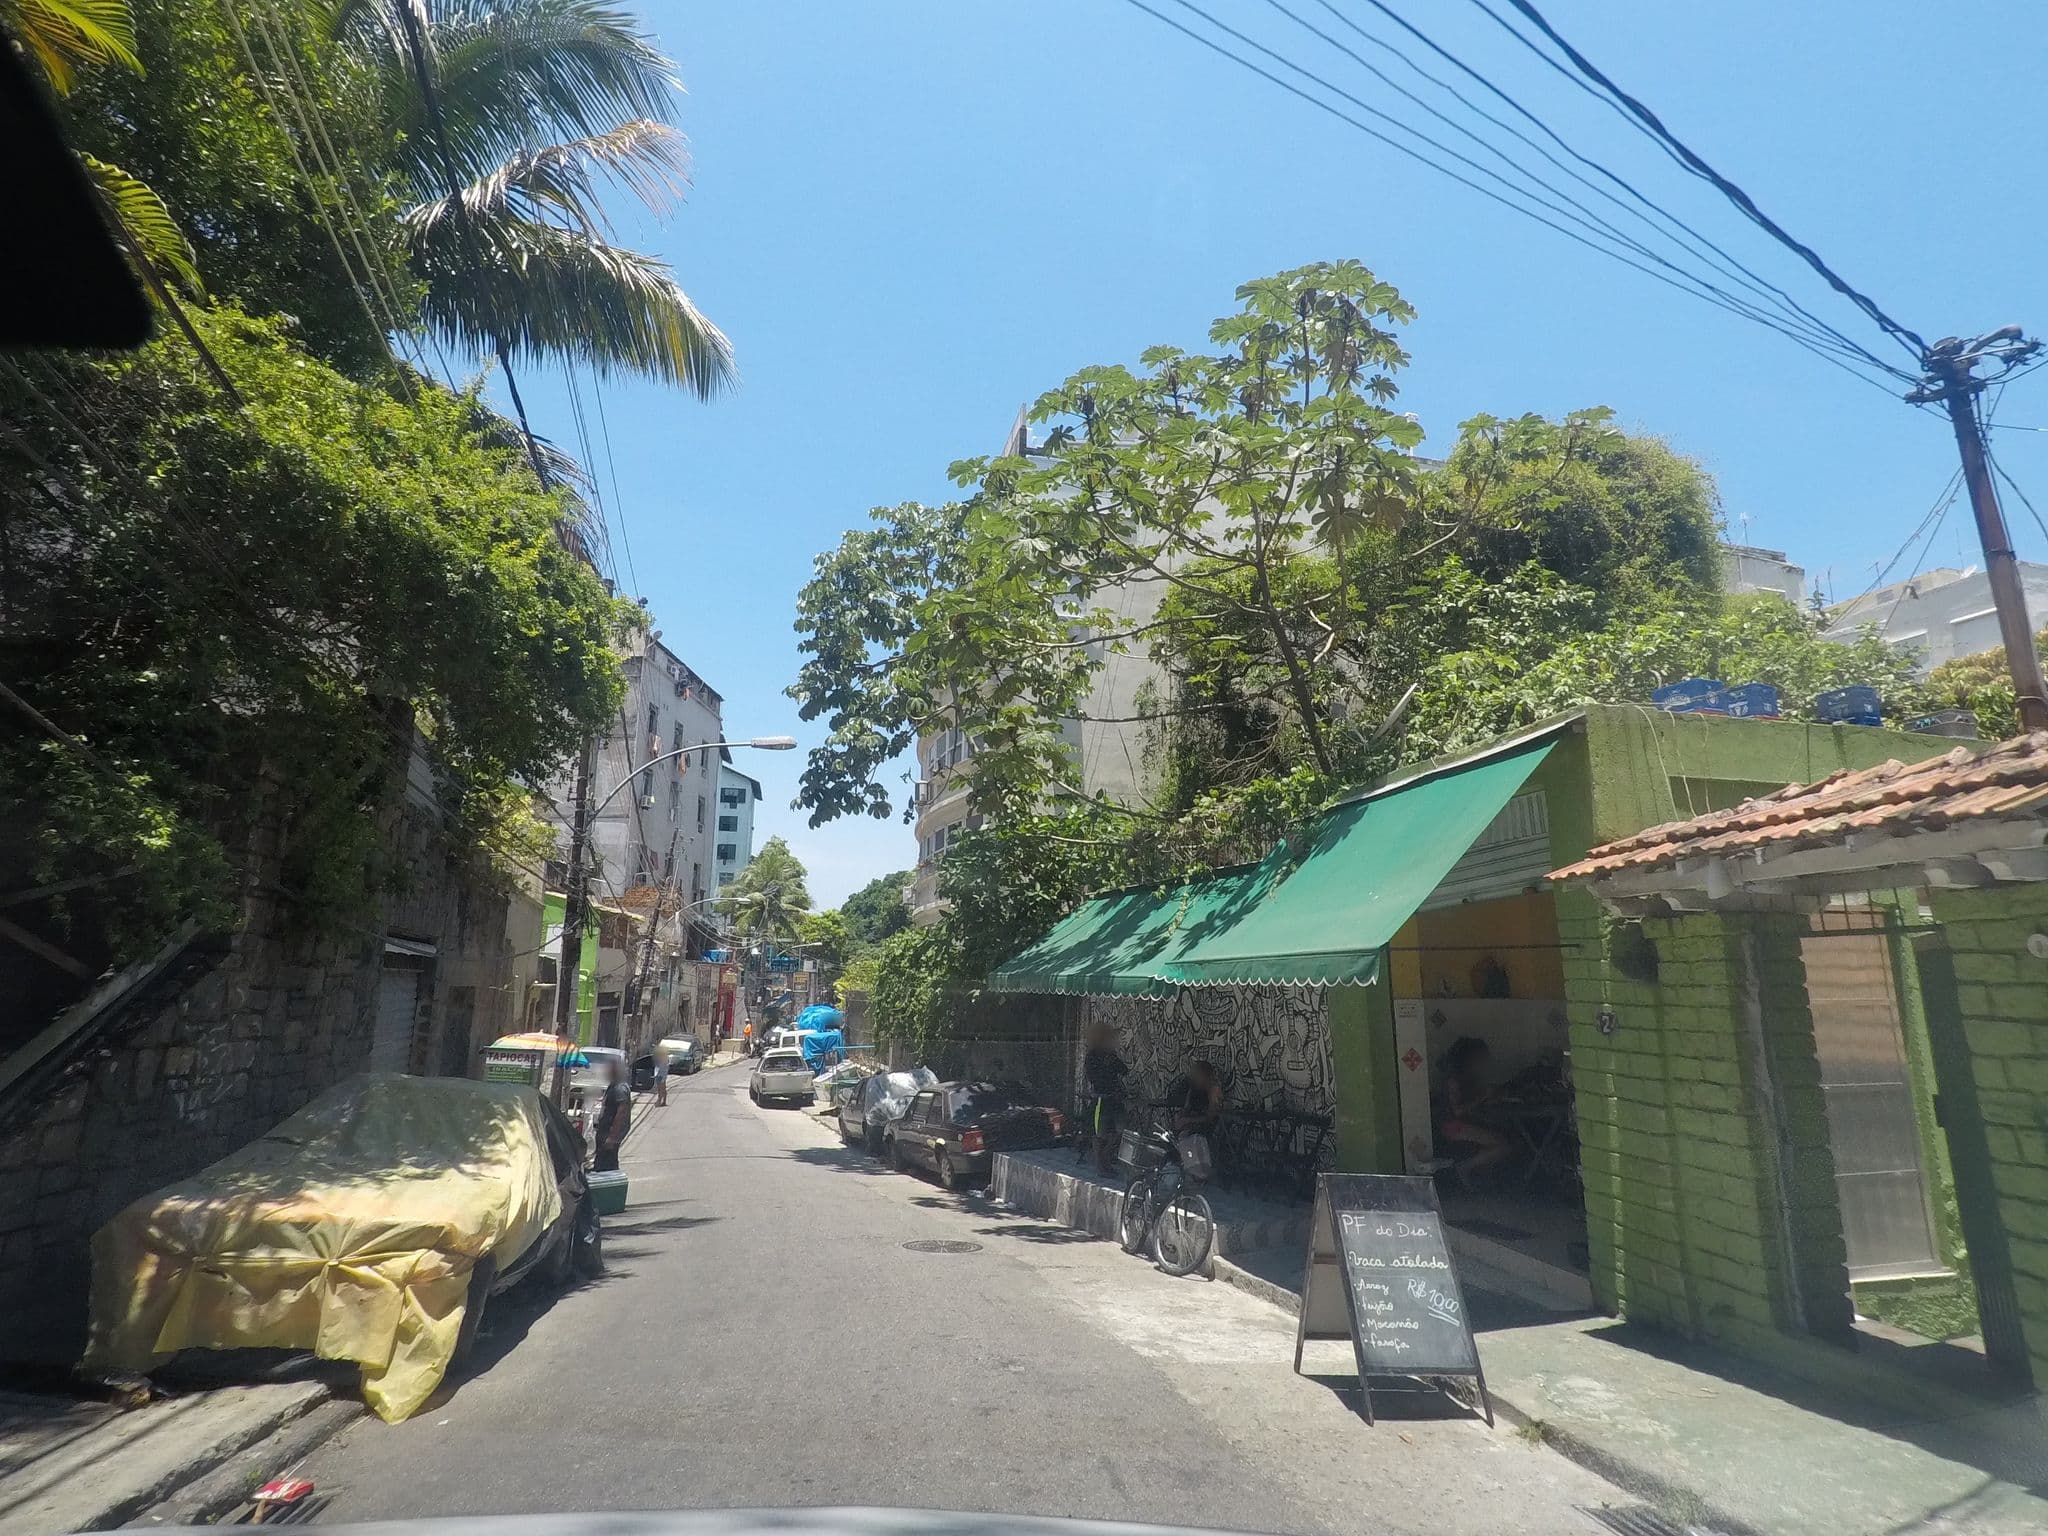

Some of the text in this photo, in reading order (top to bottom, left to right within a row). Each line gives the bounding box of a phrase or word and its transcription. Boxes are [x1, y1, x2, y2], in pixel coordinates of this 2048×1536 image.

[487, 1051, 537, 1063] TAPIOCAS
[1341, 1214, 1367, 1235] PF
[1376, 1225, 1393, 1237] do
[1348, 1250, 1449, 1269] Vaca atolada
[1407, 1278, 1427, 1299] R$
[1429, 1289, 1459, 1313] 10,00
